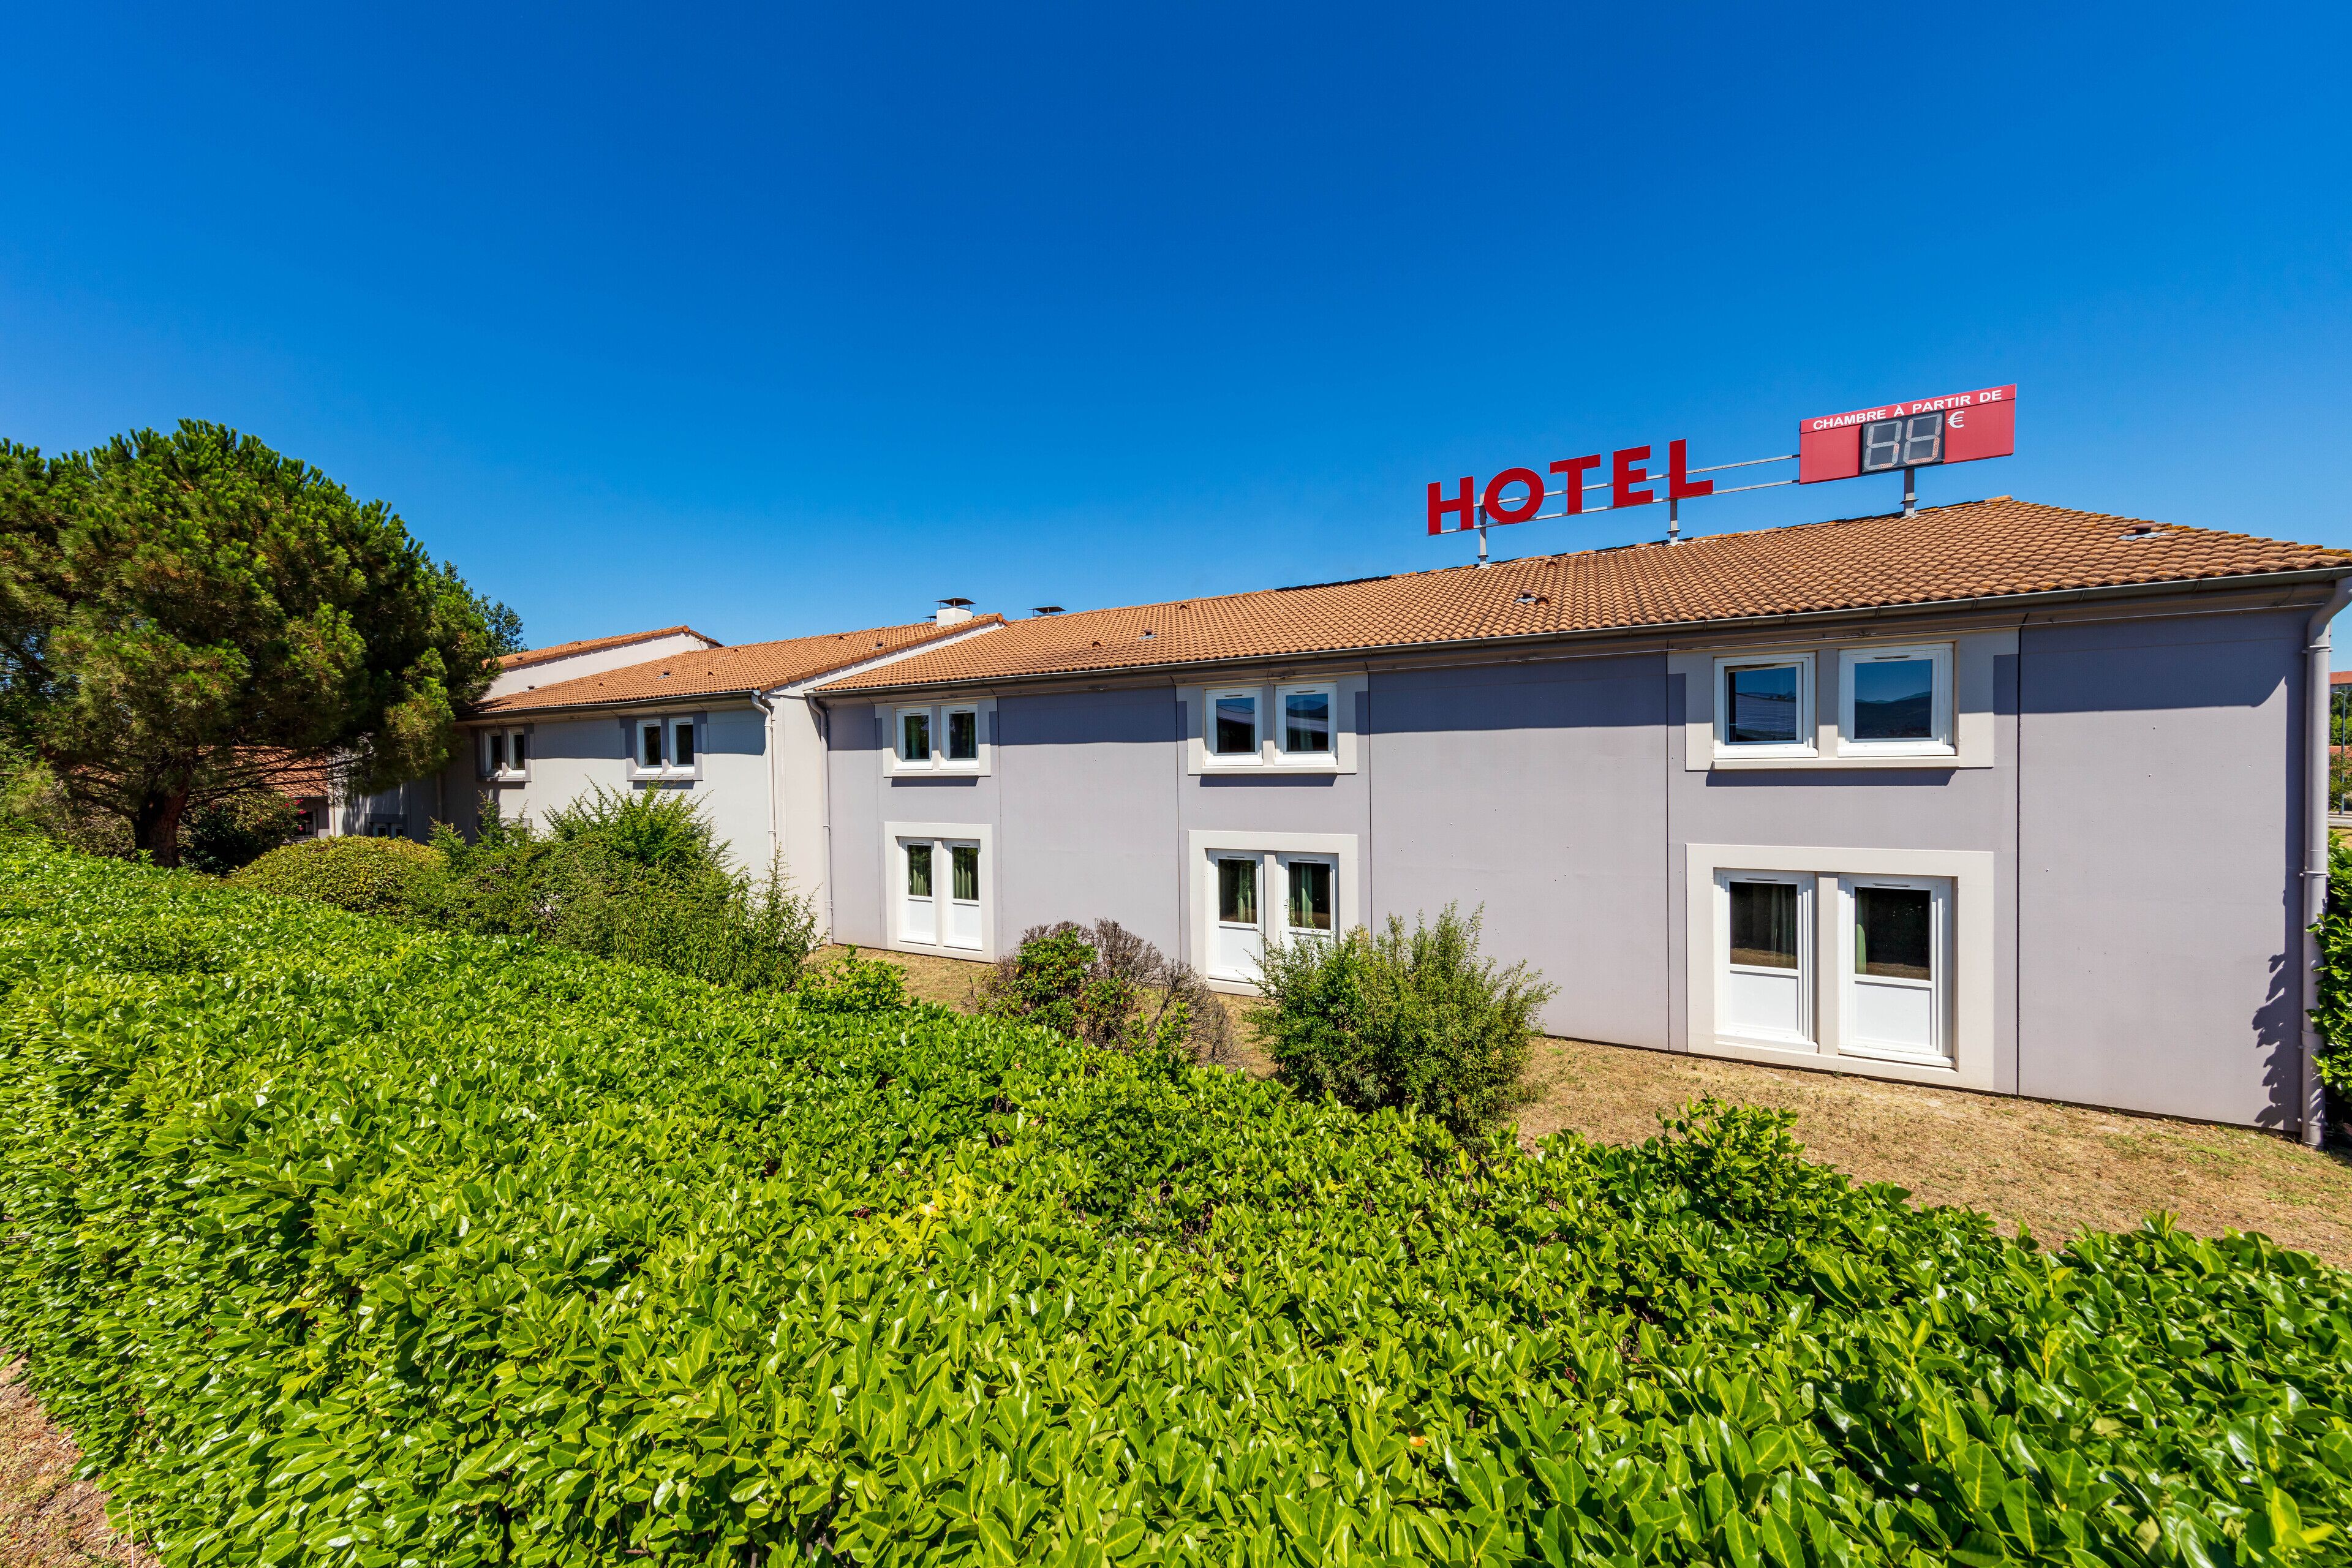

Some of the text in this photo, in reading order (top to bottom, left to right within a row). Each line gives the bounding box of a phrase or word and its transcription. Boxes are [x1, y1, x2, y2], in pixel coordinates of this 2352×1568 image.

[1813, 390, 2002, 430] CHAMBRE À PARTIR DE
[1427, 439, 1714, 535] HOTEL
